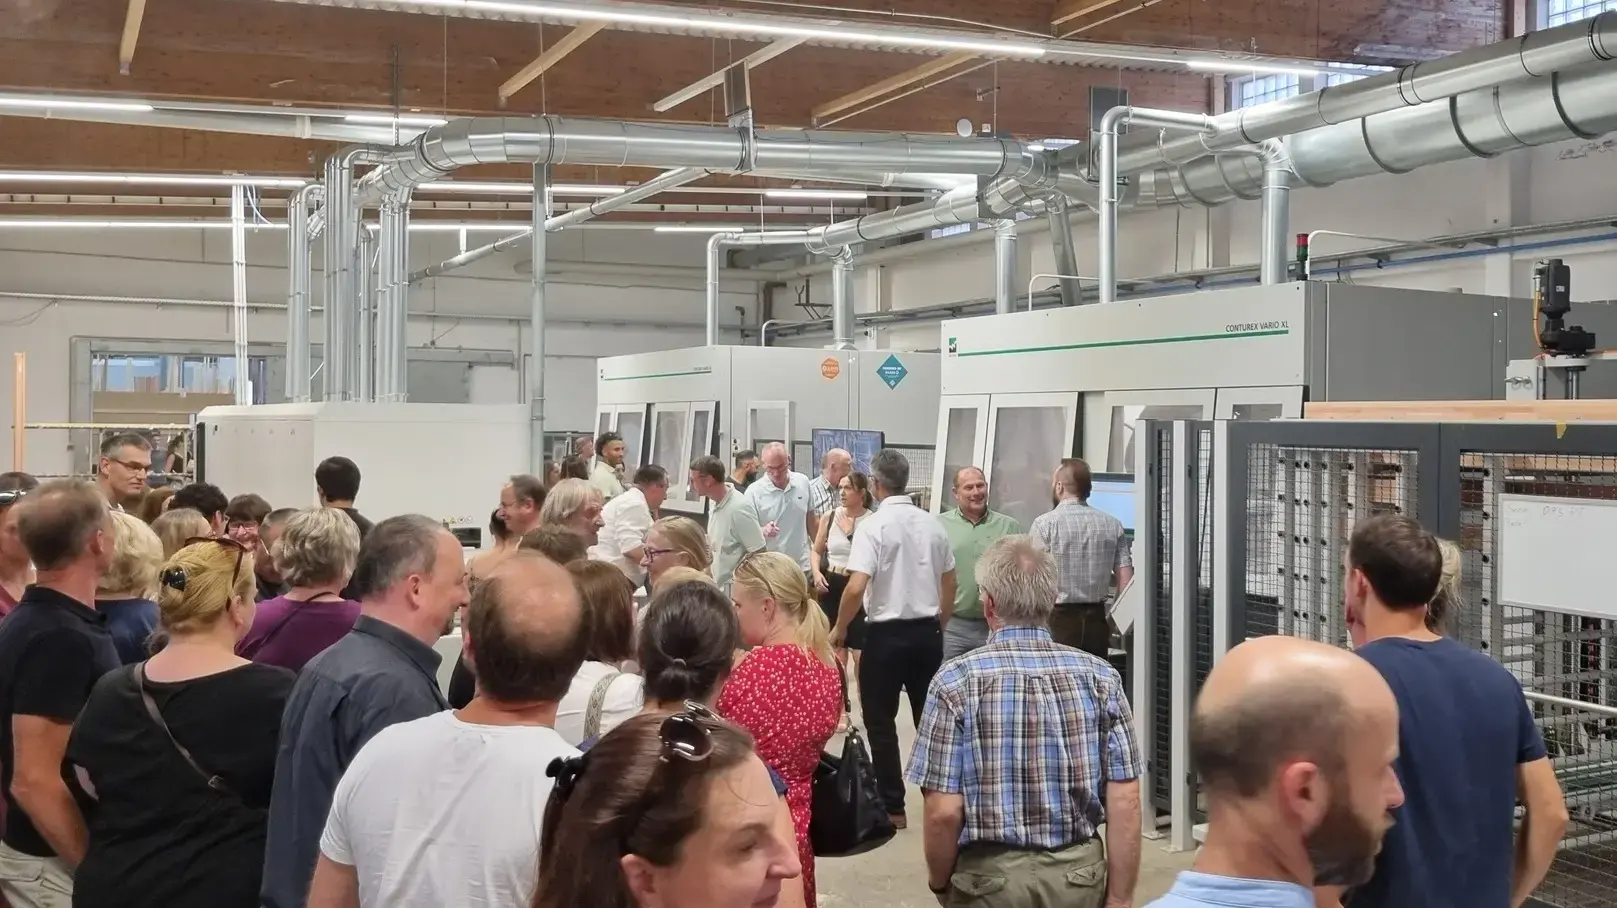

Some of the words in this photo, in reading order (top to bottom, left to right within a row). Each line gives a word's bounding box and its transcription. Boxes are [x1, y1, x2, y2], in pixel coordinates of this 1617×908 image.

[1225, 323, 1258, 332] CONTUREX
[1259, 321, 1279, 329] VARIO
[1281, 320, 1289, 328] XL
